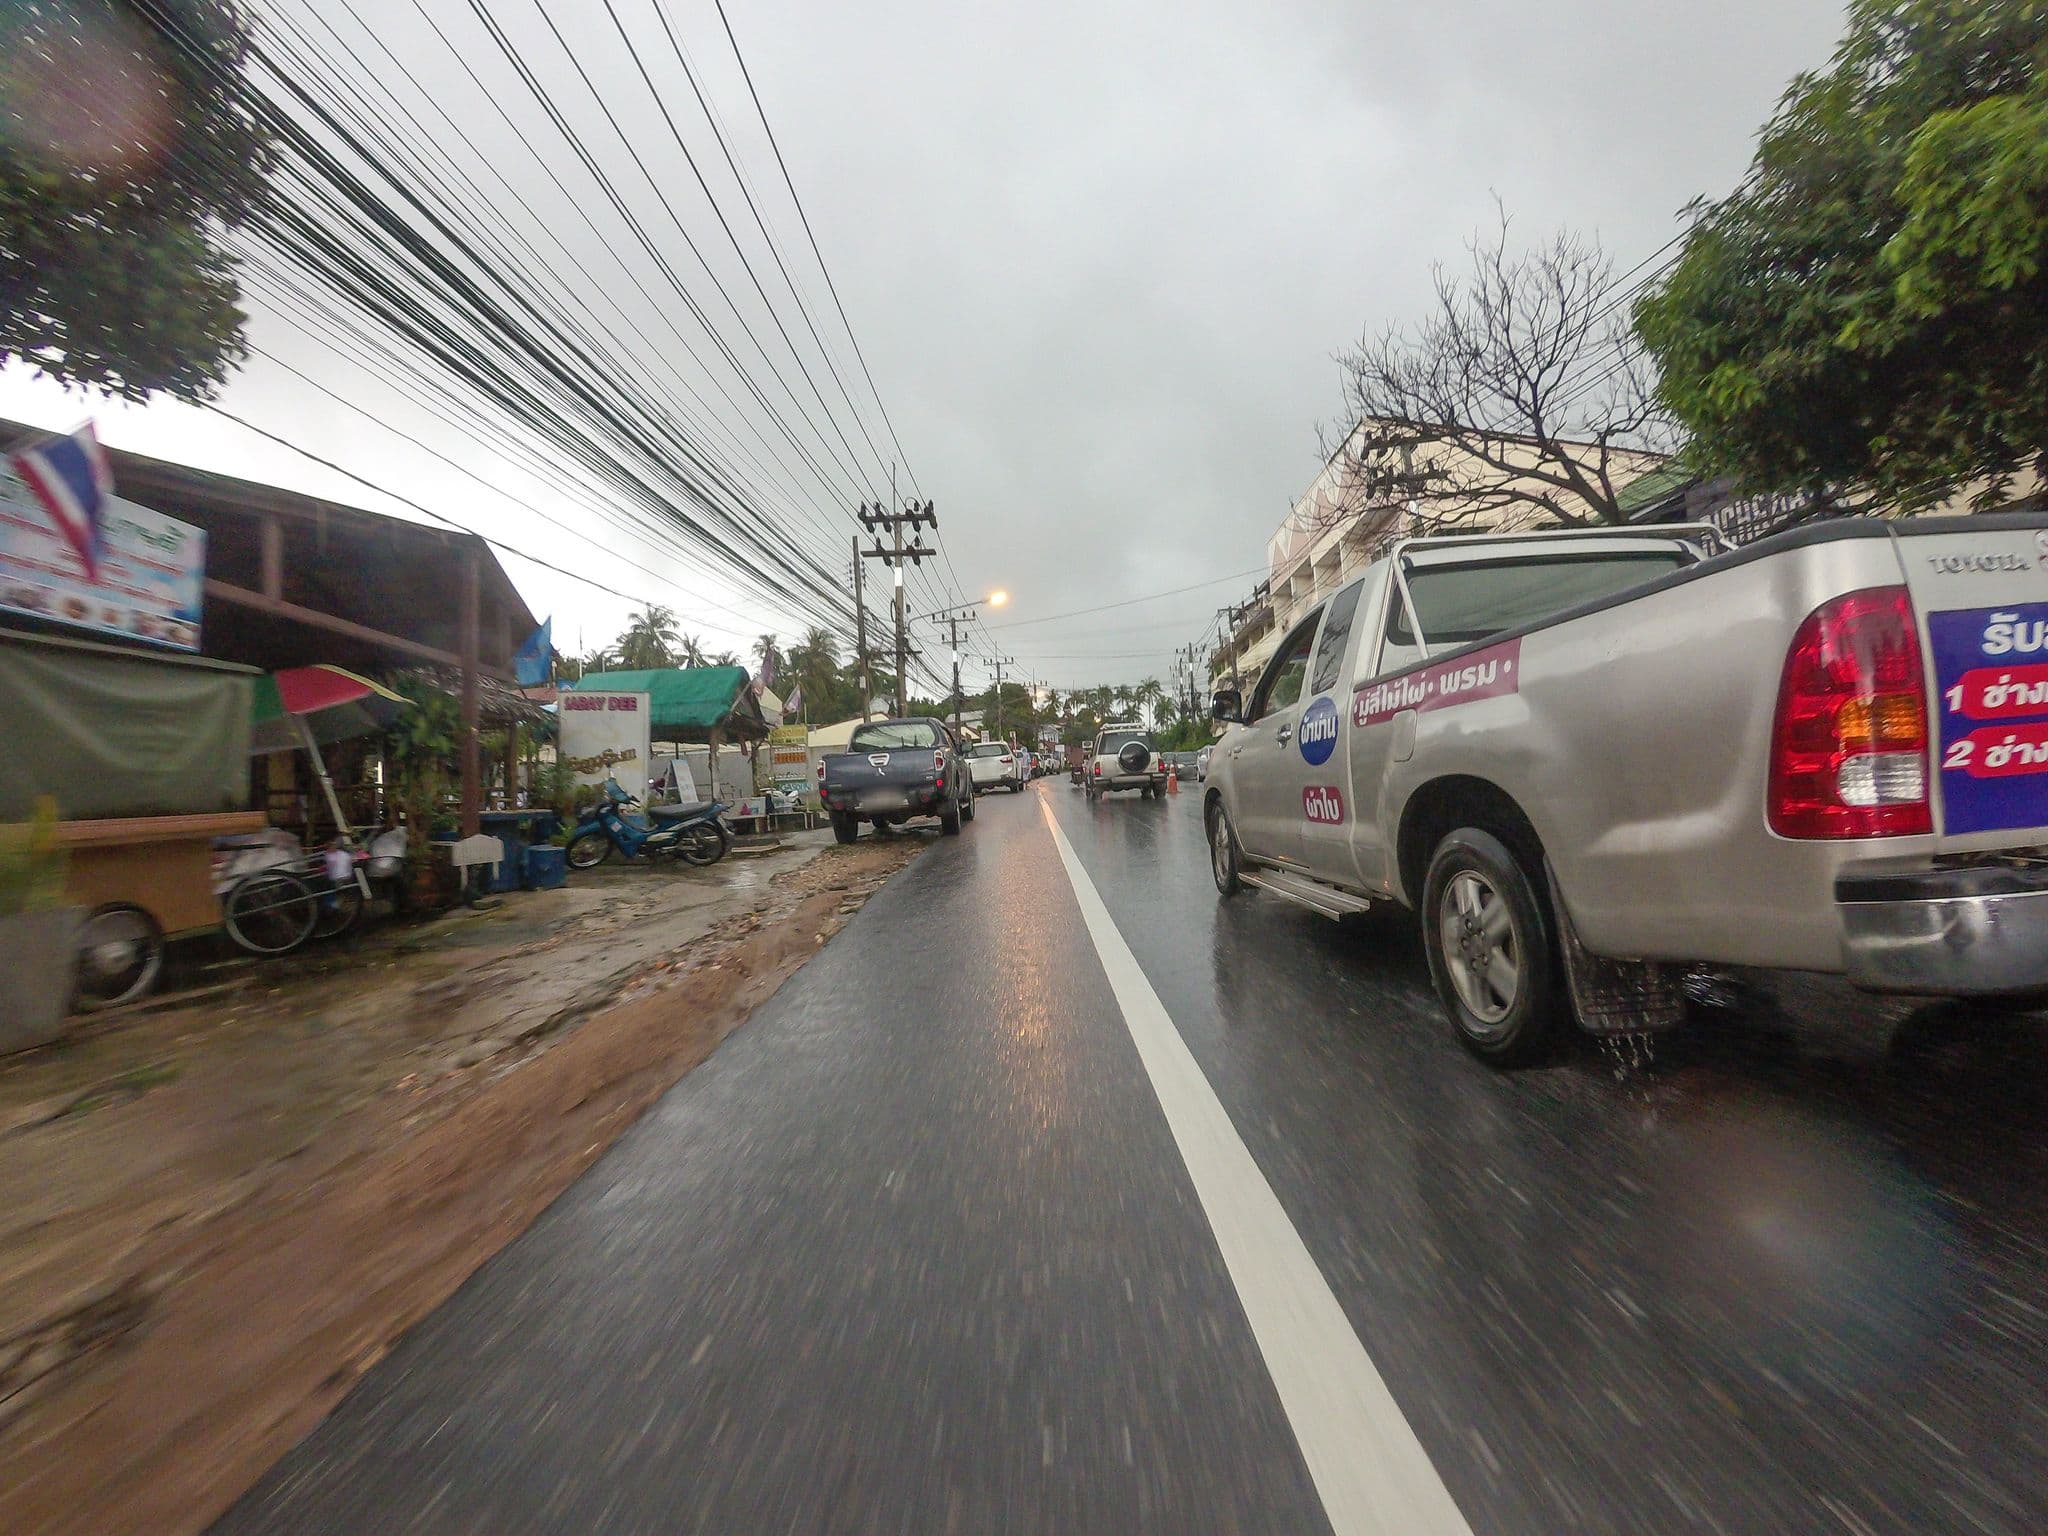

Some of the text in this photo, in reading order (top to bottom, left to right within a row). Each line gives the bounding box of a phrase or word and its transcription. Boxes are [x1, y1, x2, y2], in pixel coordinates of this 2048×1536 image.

[1928, 554, 2031, 574] TOYOTA
[1982, 612, 2048, 655] รับ
[1440, 660, 1497, 695] พรม
[1945, 685, 1964, 712] 1
[1942, 740, 1975, 768] 2
[1306, 788, 1340, 820] ผ้าใบ
